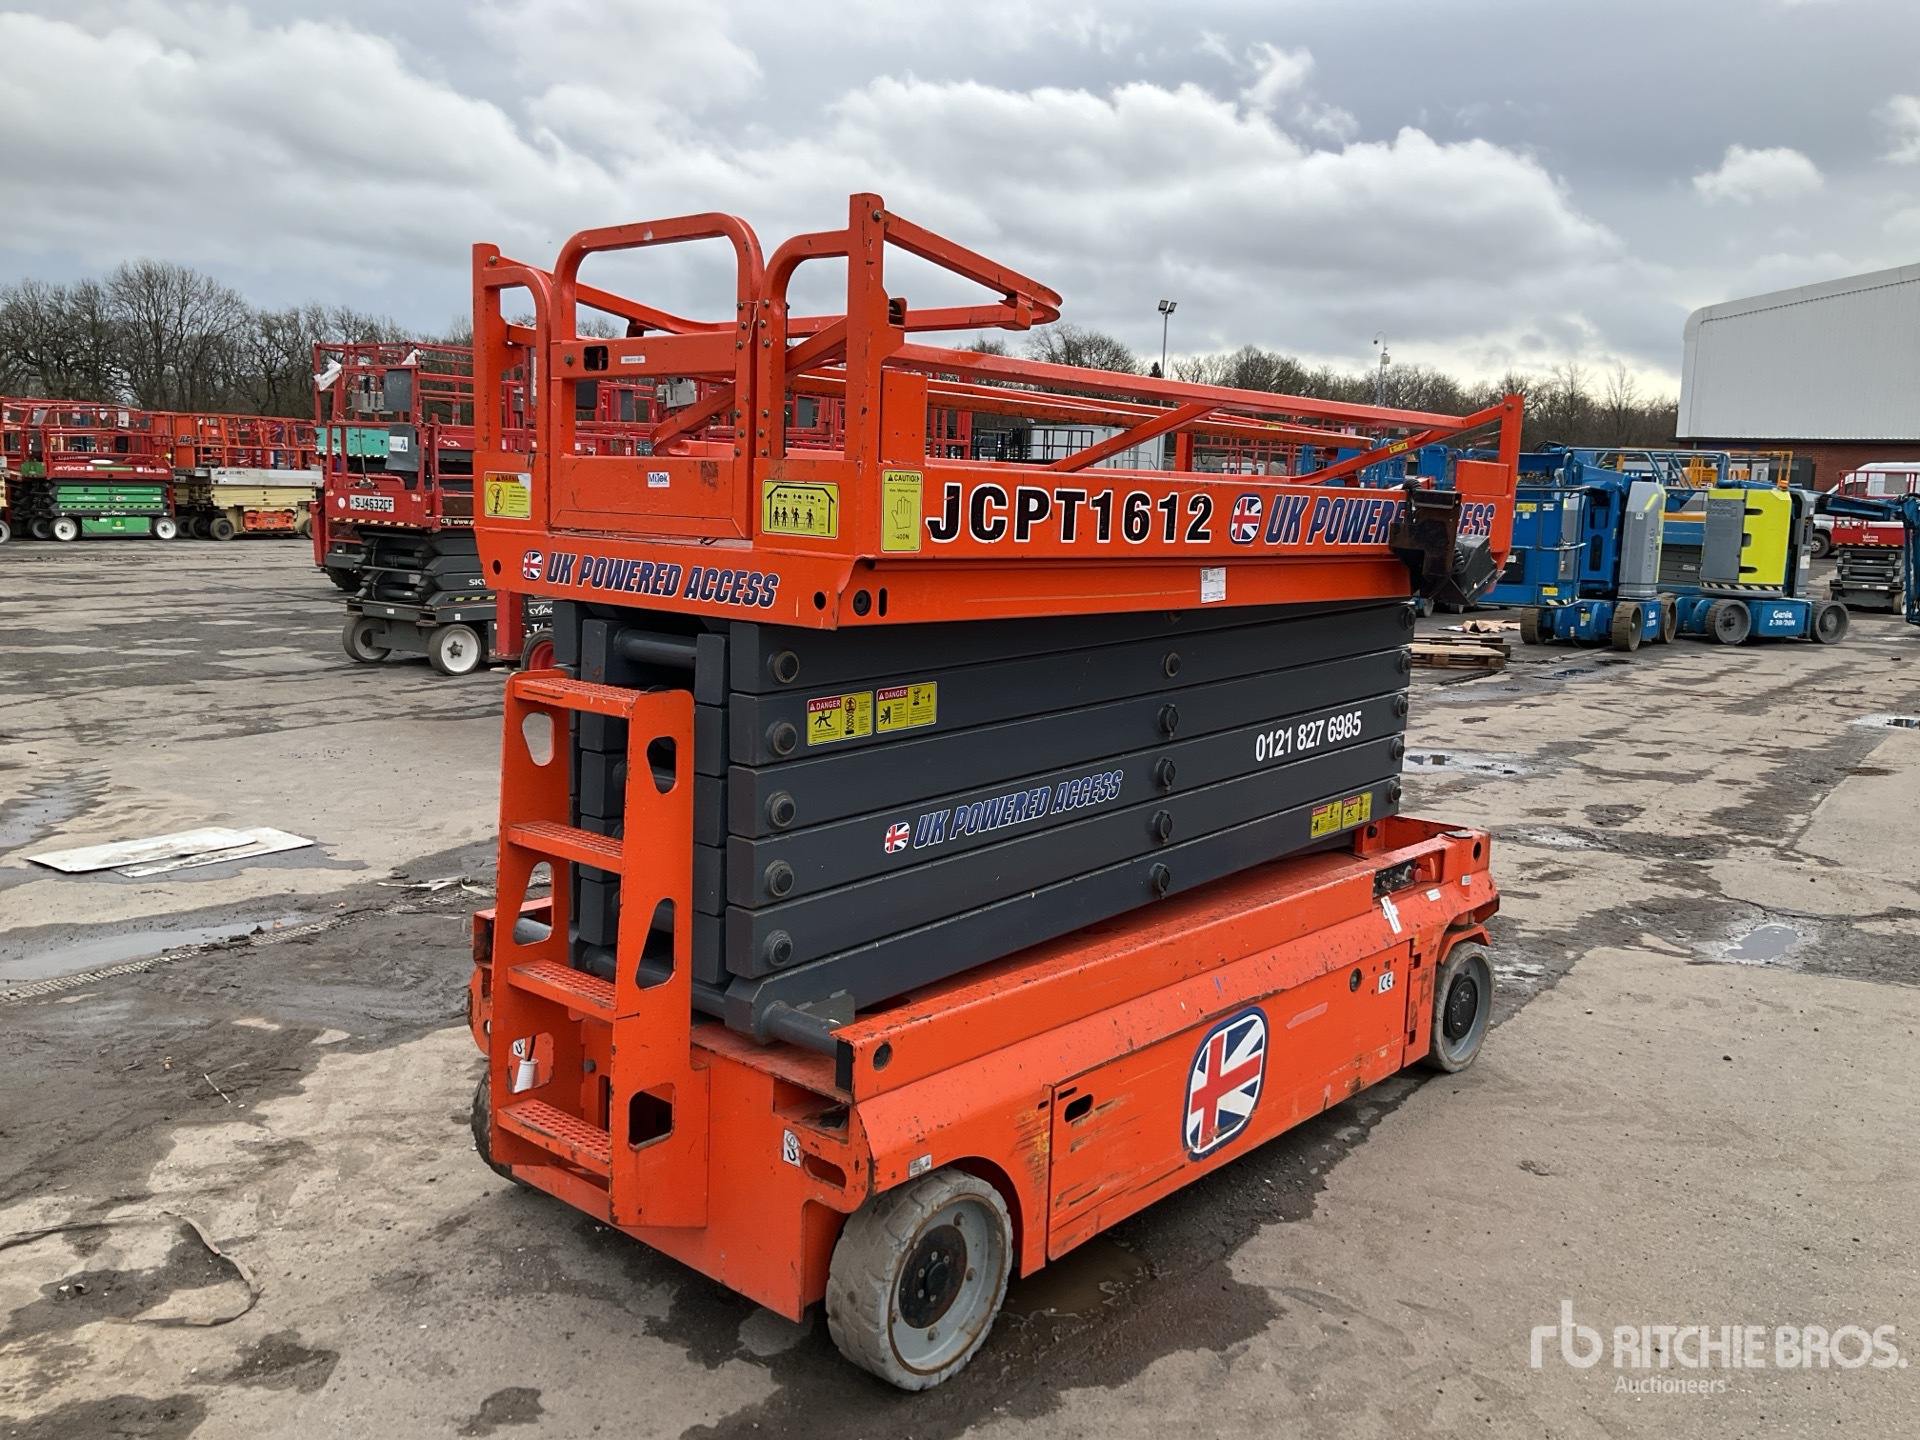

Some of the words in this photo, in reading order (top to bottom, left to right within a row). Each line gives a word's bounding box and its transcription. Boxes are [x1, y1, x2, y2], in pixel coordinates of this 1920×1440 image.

[925, 482, 1213, 545] JCPT1612
[1264, 495, 1311, 545] UK
[1306, 497, 1405, 545] POWERE
[468, 578, 486, 586] SKY
[546, 552, 573, 584] UK
[578, 555, 682, 597] POWERED
[683, 566, 780, 609] ACCESS
[816, 699, 841, 711] DANGER
[884, 689, 908, 700] DANGER
[1255, 726, 1293, 762] 0121
[1296, 719, 1325, 751] 827
[1327, 710, 1362, 743] 6985
[913, 809, 948, 849] UK
[950, 787, 1051, 840] POWERED
[1051, 770, 1123, 814] ACCESS
